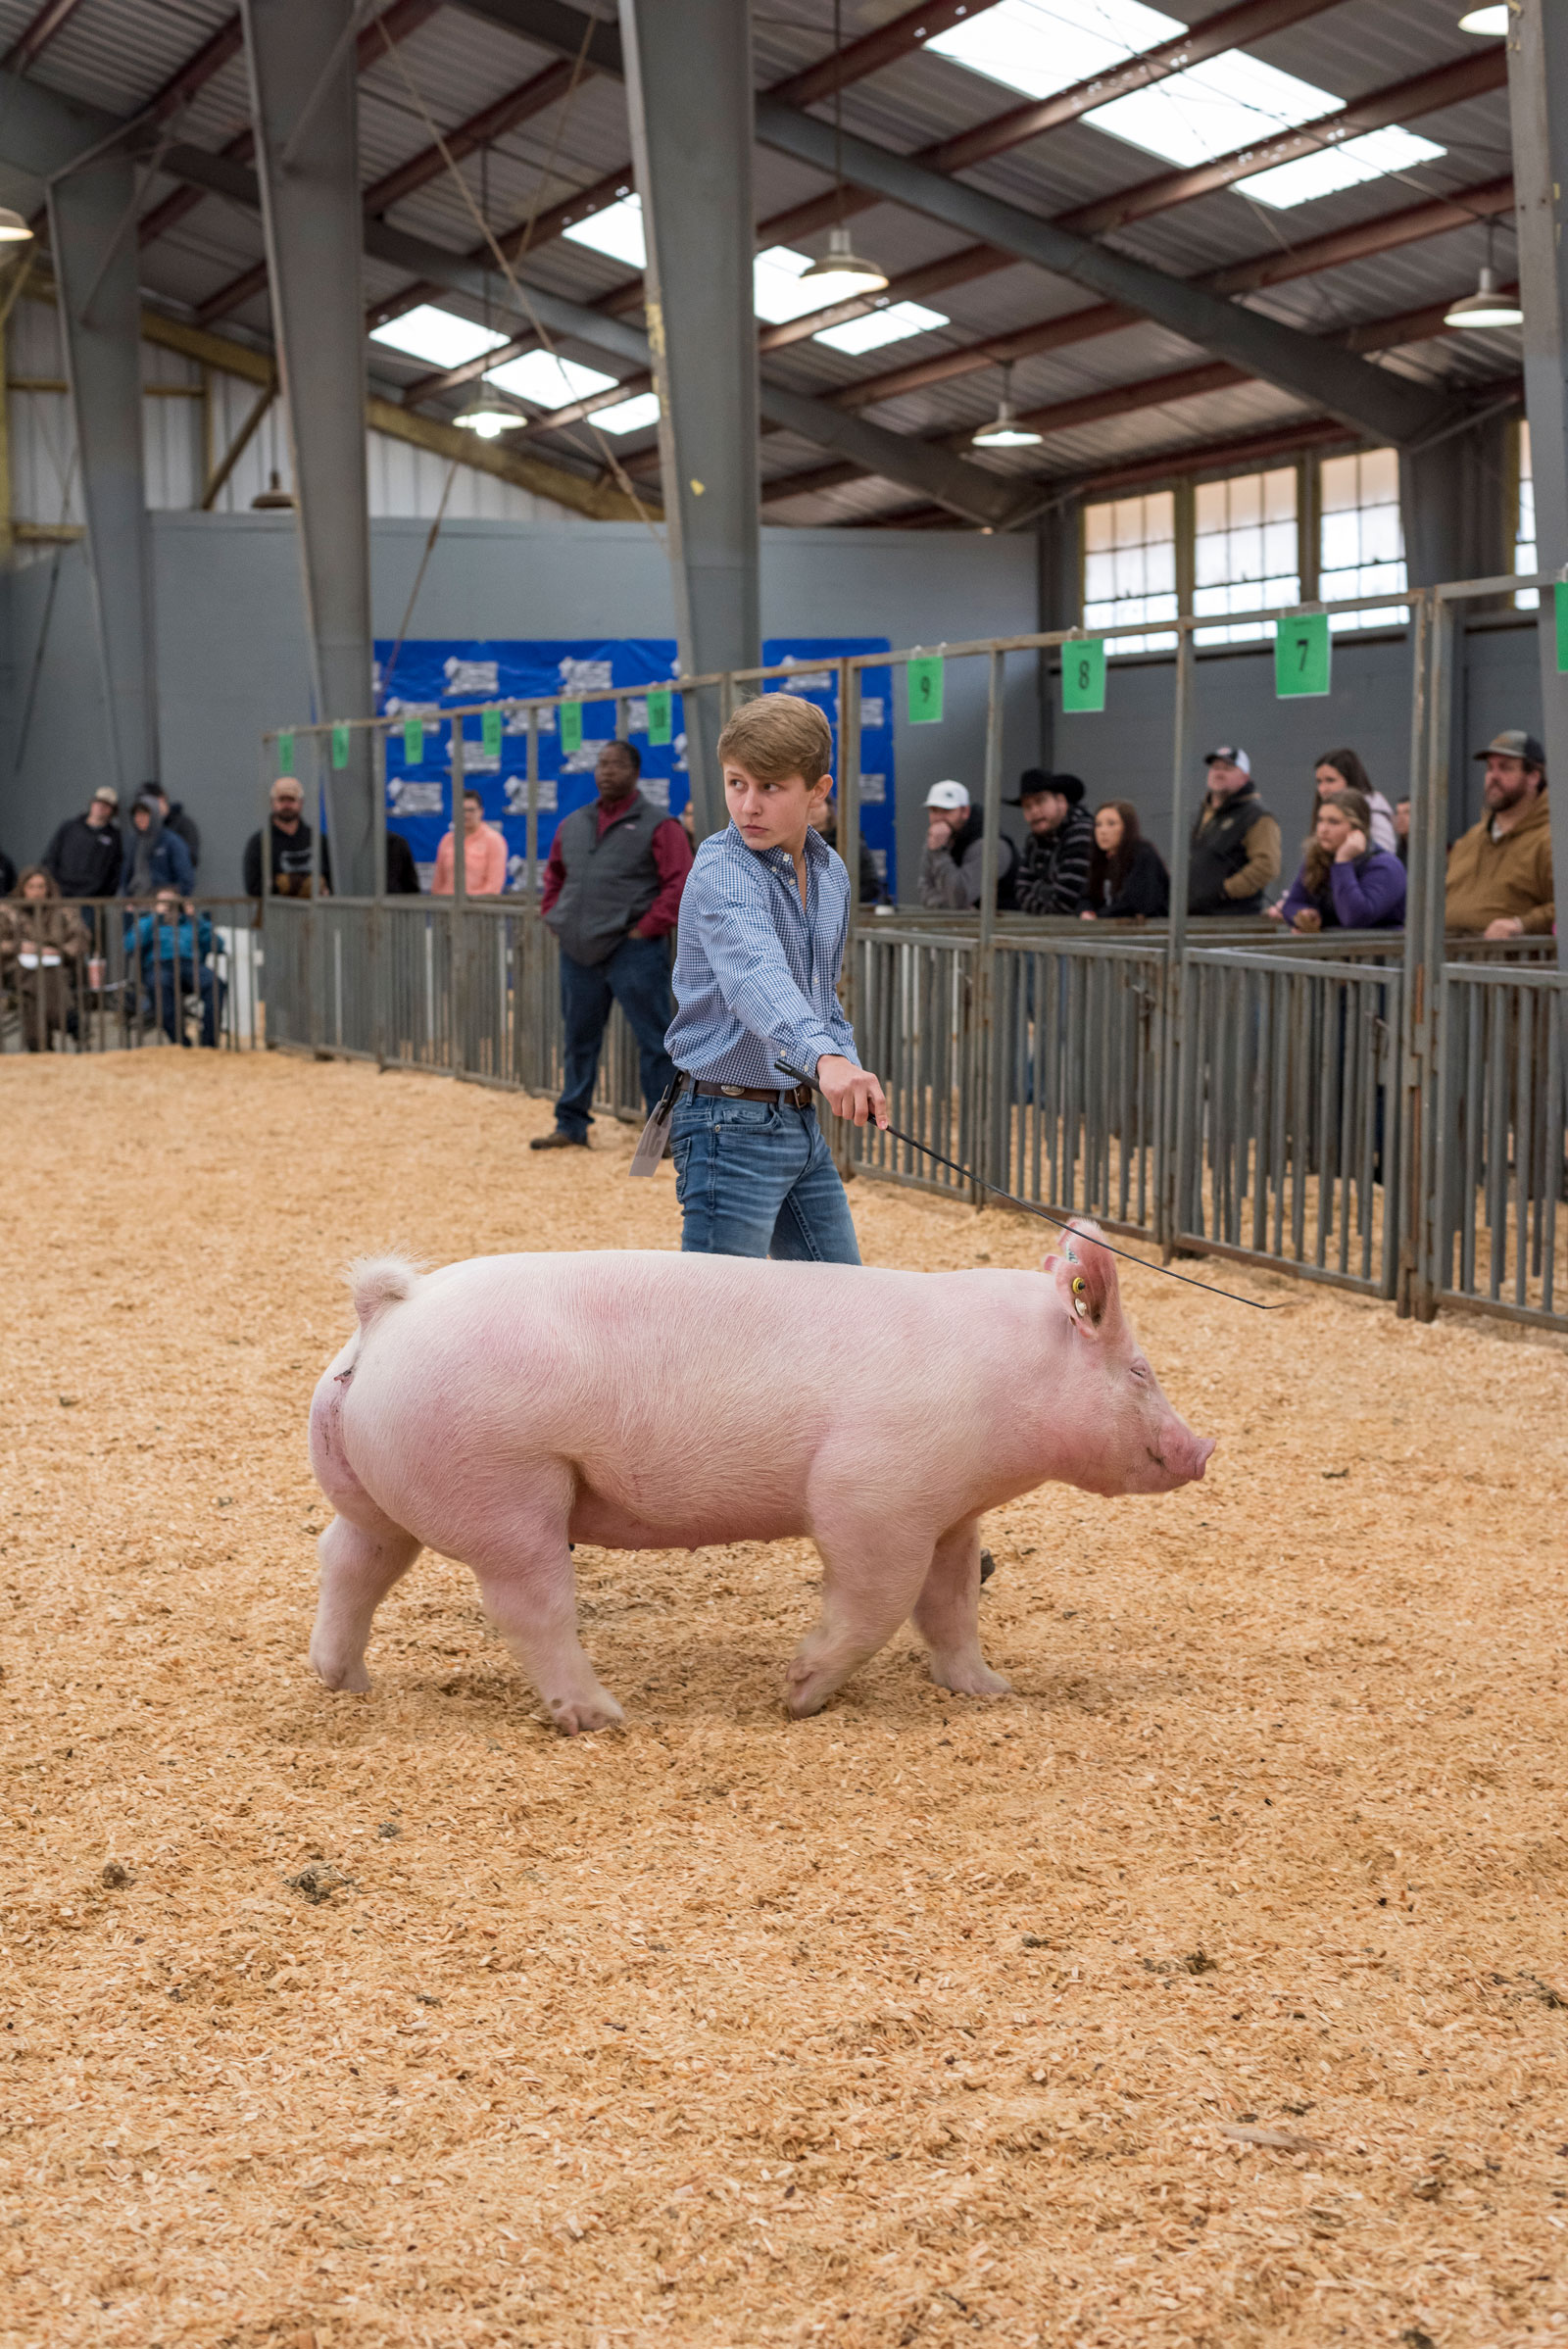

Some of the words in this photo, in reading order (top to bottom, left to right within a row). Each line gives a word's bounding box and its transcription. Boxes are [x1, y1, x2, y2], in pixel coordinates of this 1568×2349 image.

[1297, 639, 1309, 672] 7
[920, 675, 931, 704] 9
[1079, 660, 1090, 690] 8
